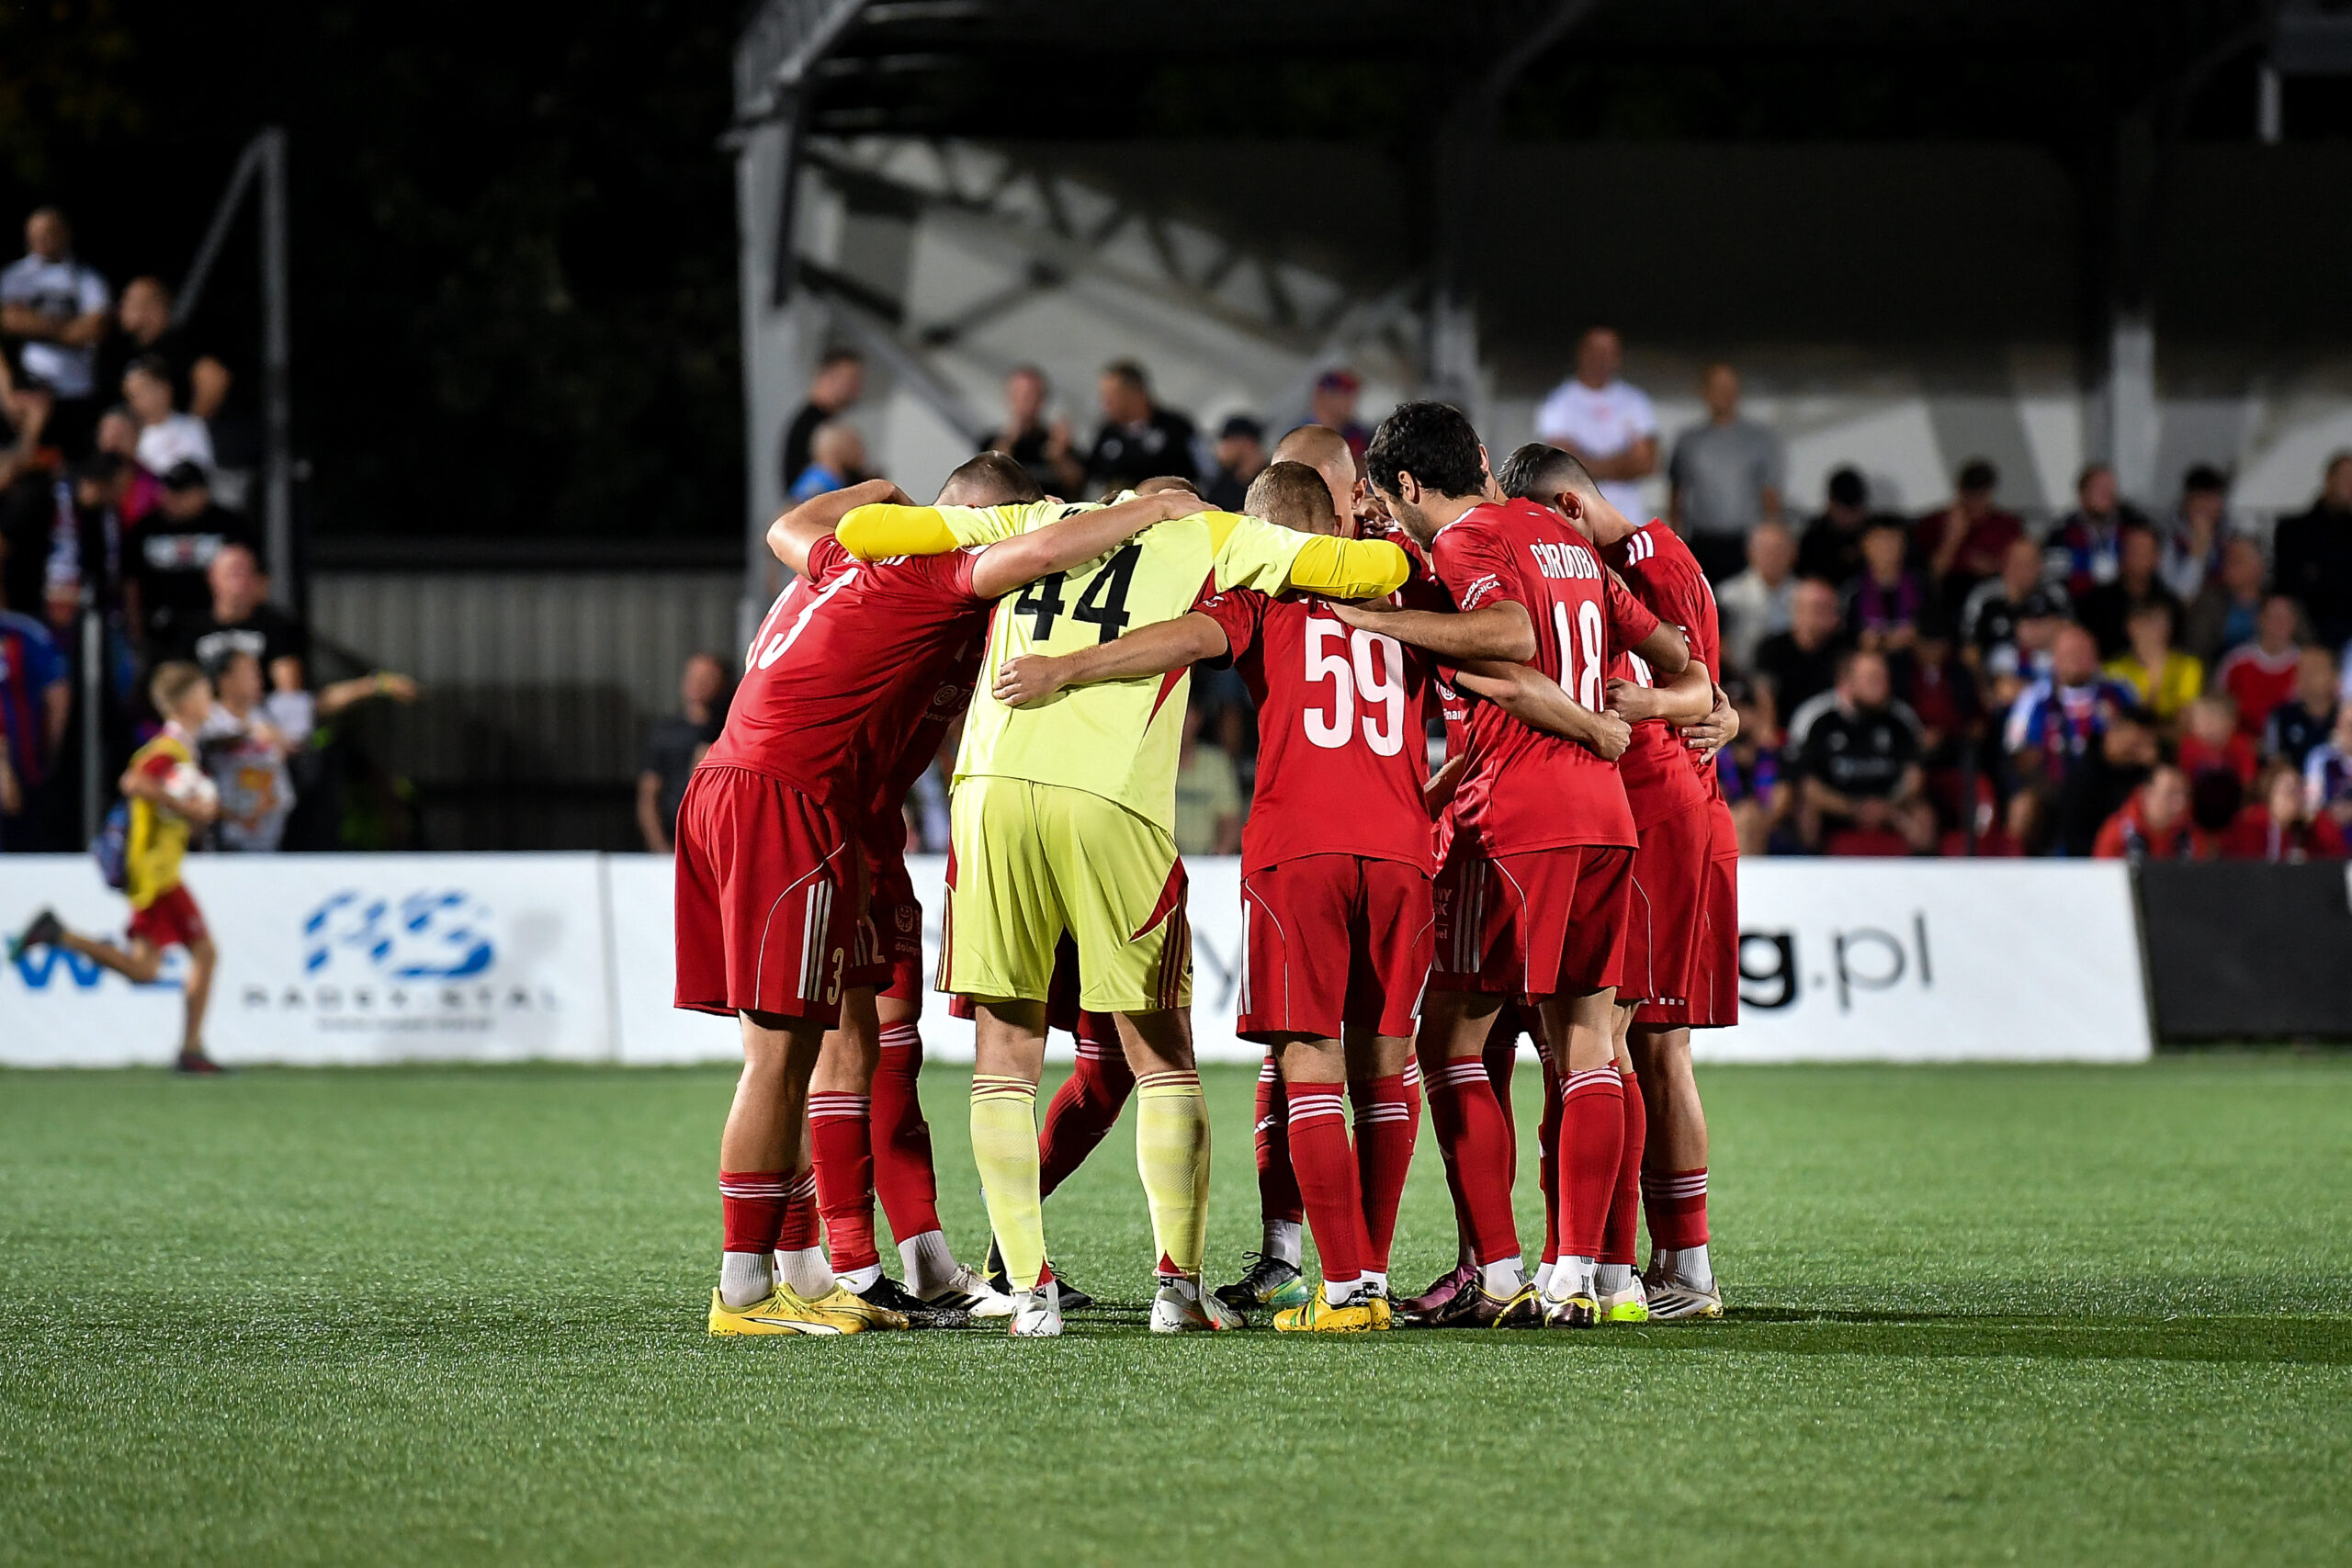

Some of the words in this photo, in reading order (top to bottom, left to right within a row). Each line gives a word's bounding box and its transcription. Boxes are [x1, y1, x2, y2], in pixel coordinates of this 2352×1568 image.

[1013, 544, 1143, 644] 44
[1469, 581, 1501, 610] LEGNICA
[1304, 615, 1405, 757] 59
[1554, 600, 1605, 714] 18
[827, 947, 844, 1006] 3
